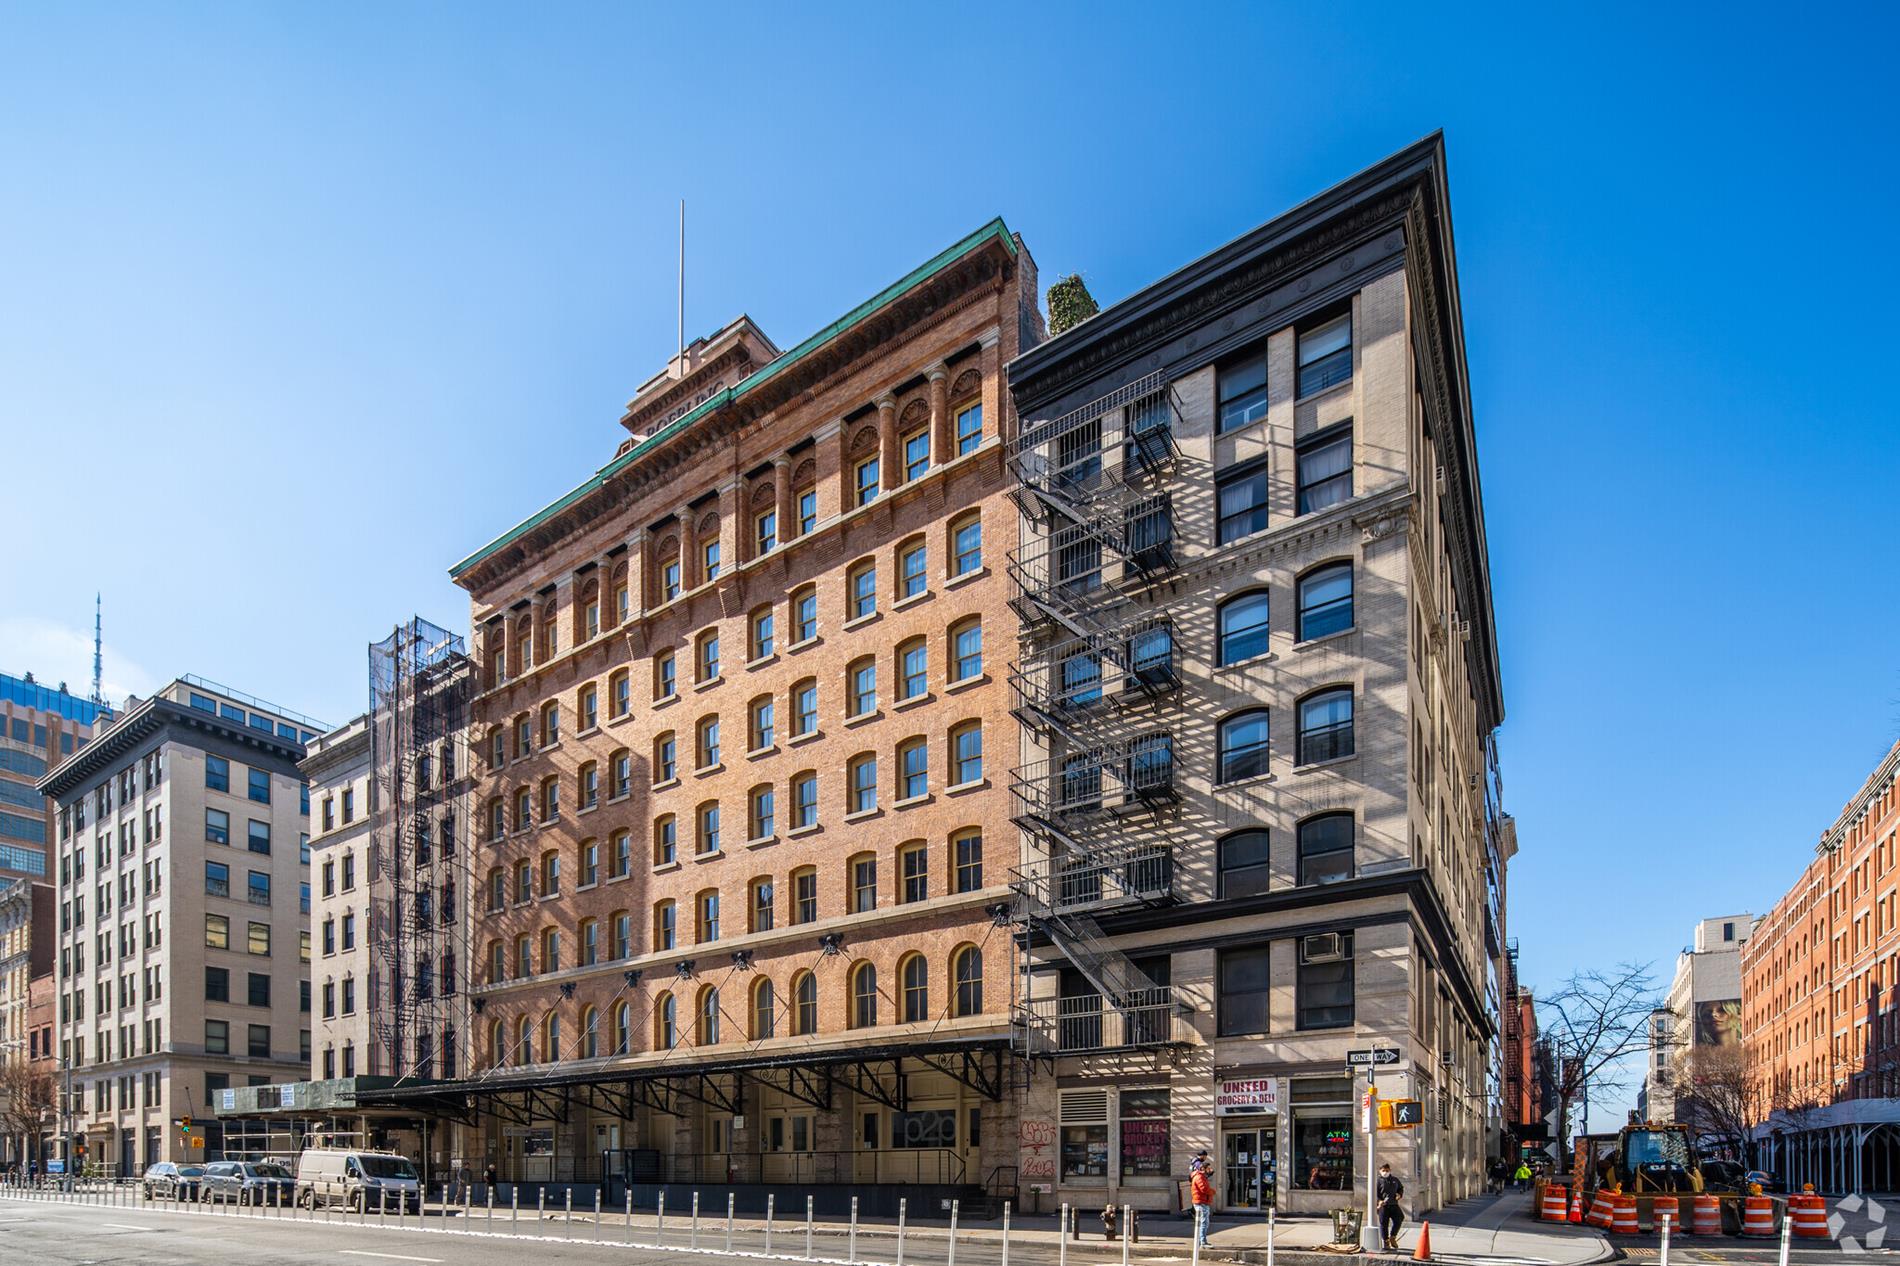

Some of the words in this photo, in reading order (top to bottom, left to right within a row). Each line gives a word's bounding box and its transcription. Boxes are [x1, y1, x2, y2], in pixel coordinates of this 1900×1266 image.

[1223, 1080, 1268, 1093] UNITED
[1217, 1094, 1250, 1105] GROCERY
[1252, 1096, 1257, 1104] &
[1259, 1093, 1275, 1103] DELI
